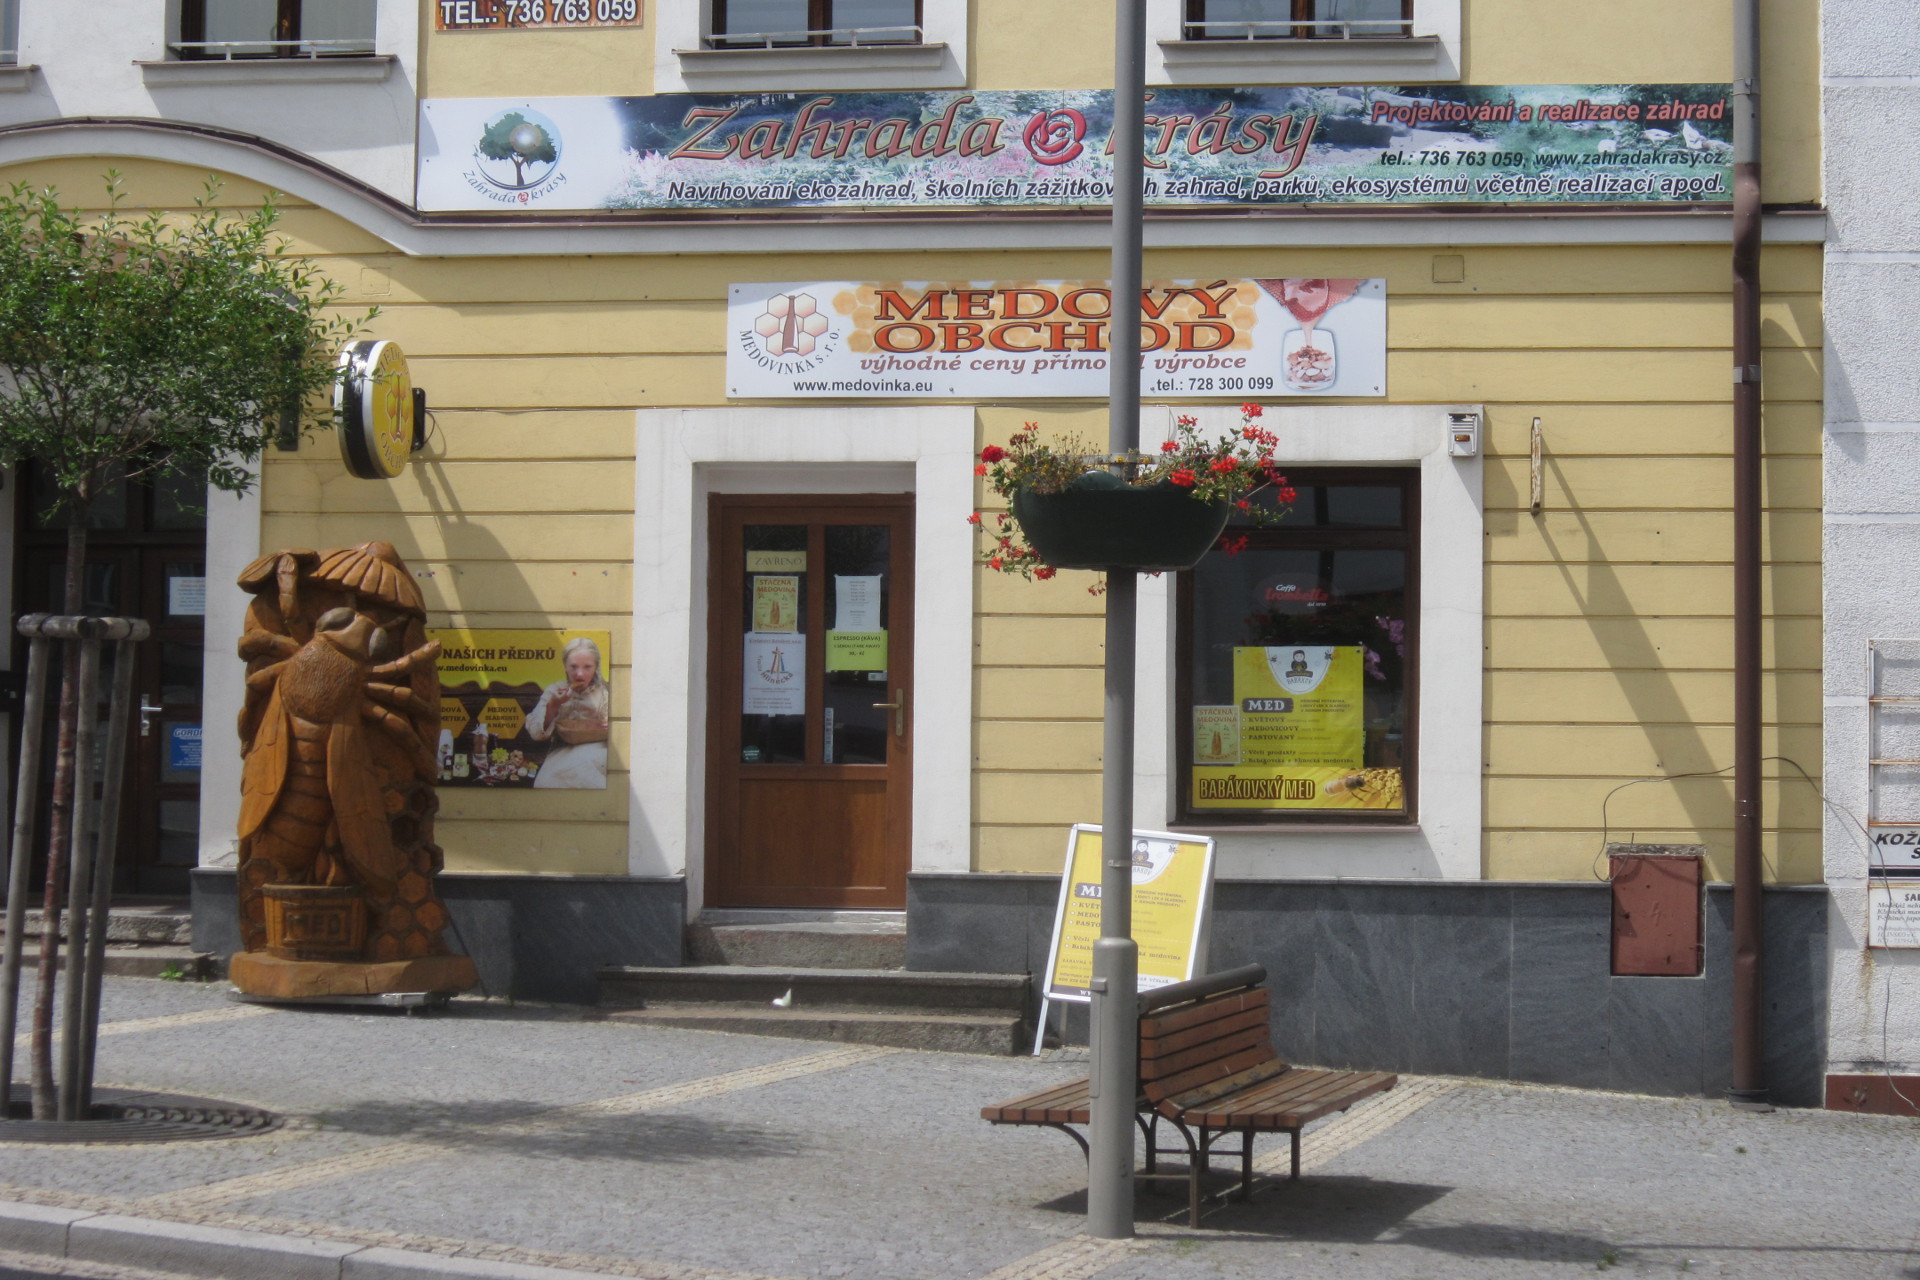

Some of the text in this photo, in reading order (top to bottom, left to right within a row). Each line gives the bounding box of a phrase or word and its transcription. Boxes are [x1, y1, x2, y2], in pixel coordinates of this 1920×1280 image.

[441, 0, 636, 24] TEL.: 736 763 059
[1372, 99, 1725, 127] Projektování a realizace zahrad
[668, 95, 1004, 160] Zahrada
[1380, 151, 1414, 166] tel.:
[1419, 151, 1451, 165] 736
[1456, 151, 1486, 166] 763
[1536, 150, 1723, 168] www.zahradakrasy.cz
[463, 170, 567, 203] Zahrada krásy
[668, 173, 1725, 200] Navrhování ekozahrad, školních zážitkovh zahrad, parků, ekosystémů včetně realizací apod.
[874, 279, 1237, 321] MEDOVÝ
[874, 322, 1235, 354] OBCHOD
[740, 329, 815, 375] MEDOVINKA
[860, 355, 961, 374] výhodné
[970, 358, 1027, 374] ceny
[1032, 353, 1107, 374] přímo
[1154, 353, 1247, 374] výrobce
[794, 379, 933, 392] www.medovinka.eu
[1157, 377, 1274, 391] tel.: 728 300 099
[442, 646, 556, 660] NAŠICH PŘEDKŮ
[437, 664, 507, 673] w.medovinka.eu
[1248, 699, 1285, 711] MED
[1200, 775, 1316, 800] BABÁKOVSKÝ MED
[1876, 830, 1920, 846] KOŽ
